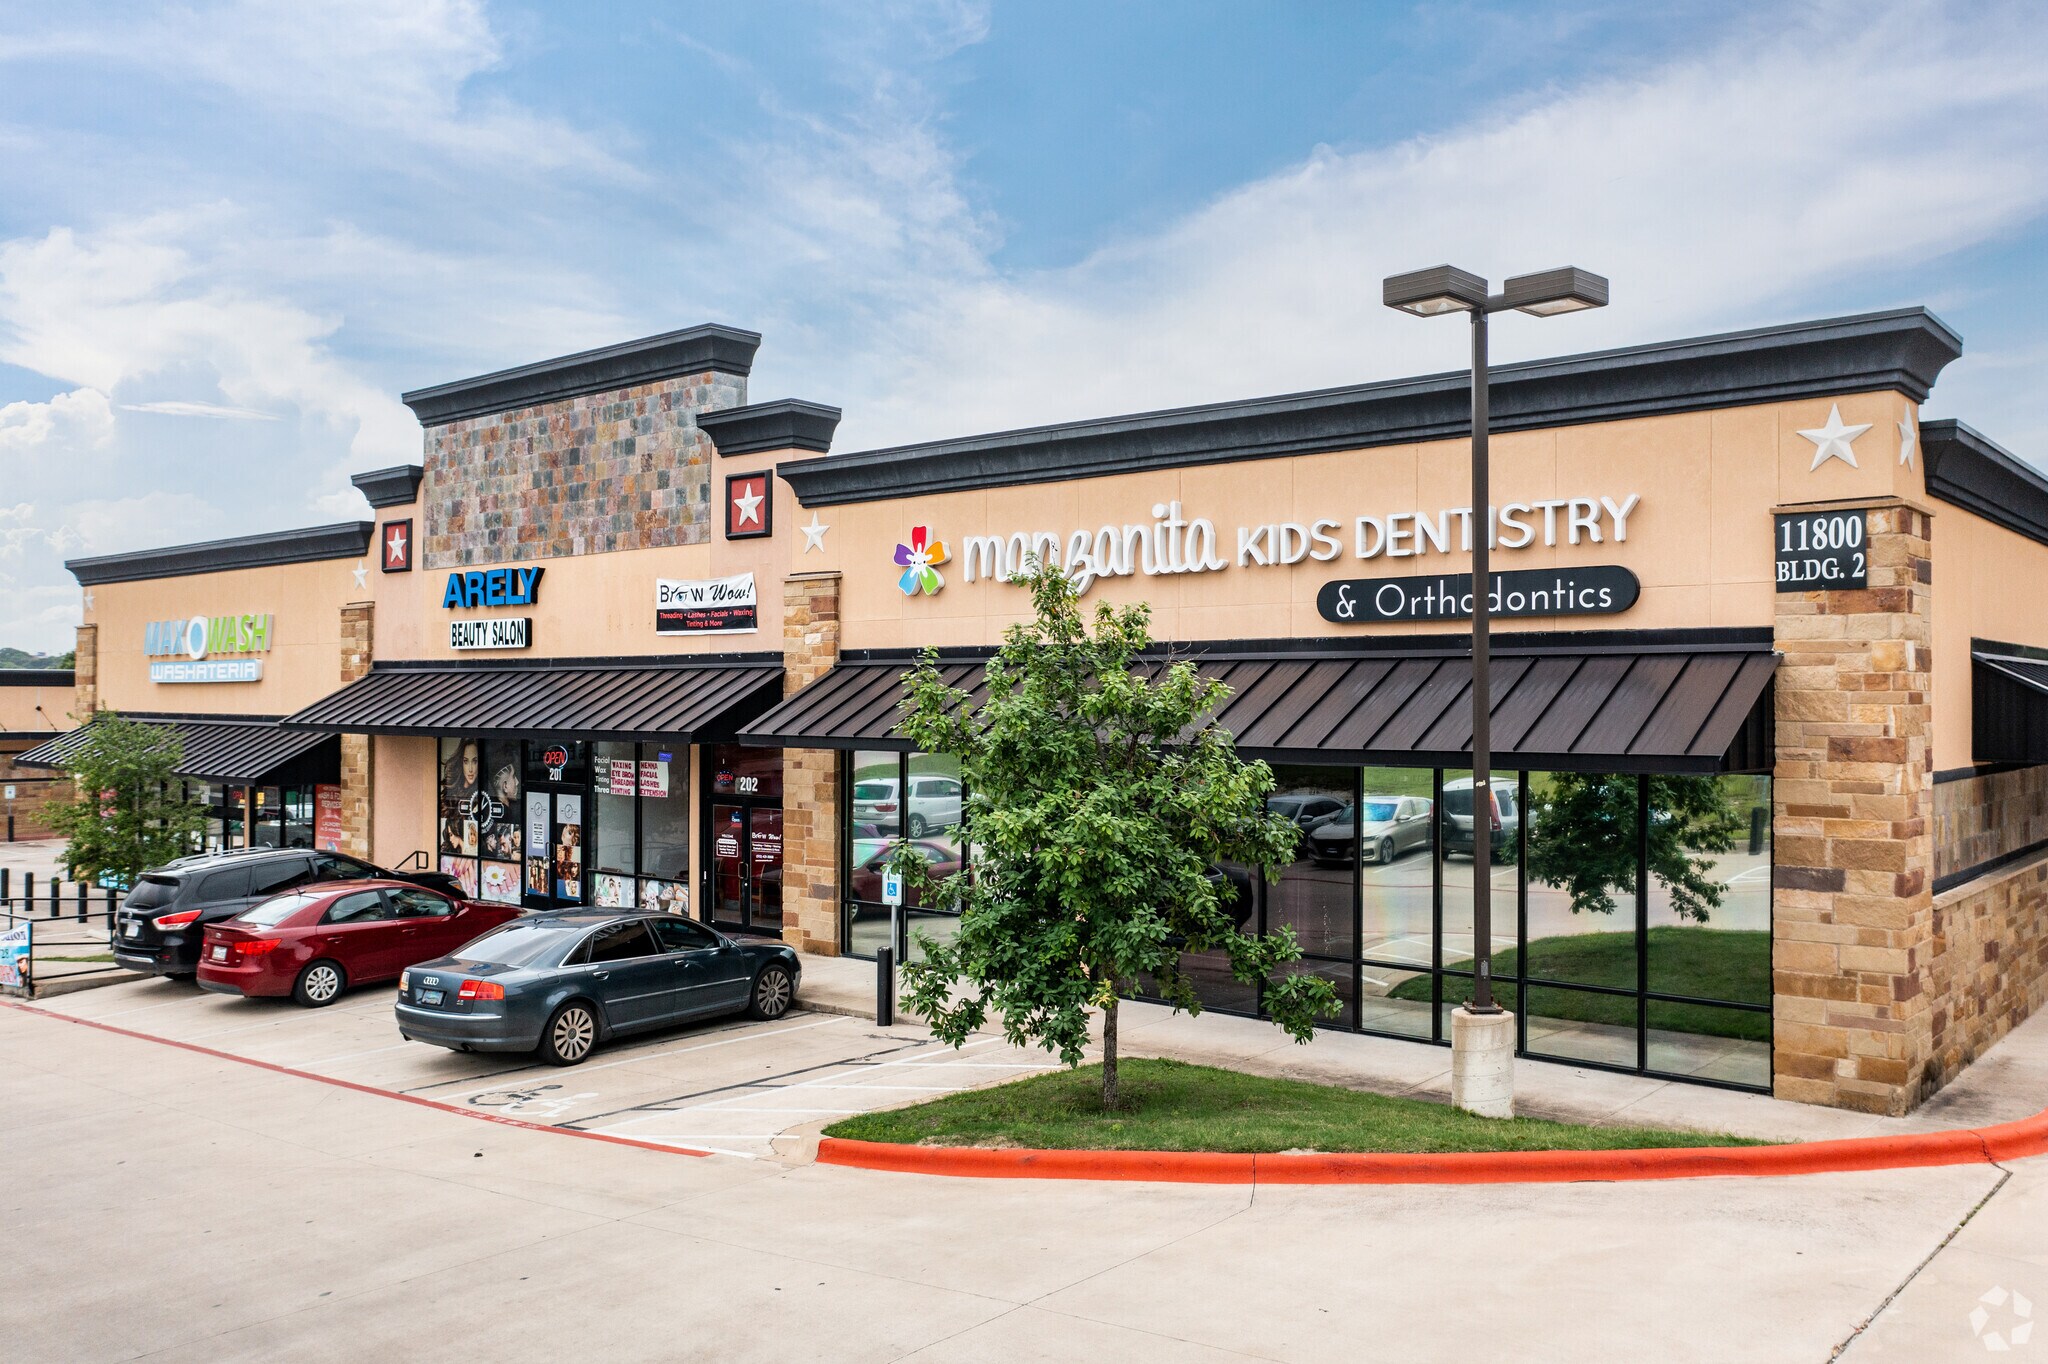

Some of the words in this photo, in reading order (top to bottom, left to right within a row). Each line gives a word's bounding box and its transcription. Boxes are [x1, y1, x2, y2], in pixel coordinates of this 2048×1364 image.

[1781, 515, 1862, 552] 11800
[963, 501, 1229, 597] manzanita
[1237, 519, 1343, 567] KIDS
[1355, 493, 1641, 560] DENTISTRY
[1776, 557, 1845, 582] BLDG.
[1851, 552, 1865, 578] 2
[442, 567, 542, 609] ARELY
[709, 582, 753, 601] Wow!
[1336, 584, 1356, 618] &
[1375, 575, 1612, 617] Orthodontics
[733, 609, 753, 617] Waxing
[451, 622, 488, 647] BEAUTY
[492, 620, 524, 646] SALON
[151, 662, 256, 680] WASHATERIA
[544, 751, 565, 765] OPEN
[594, 756, 610, 764] Facial
[549, 768, 562, 781] 201
[640, 771, 658, 779] FACIAL
[640, 780, 659, 788] LASHES
[740, 776, 758, 792] 202
